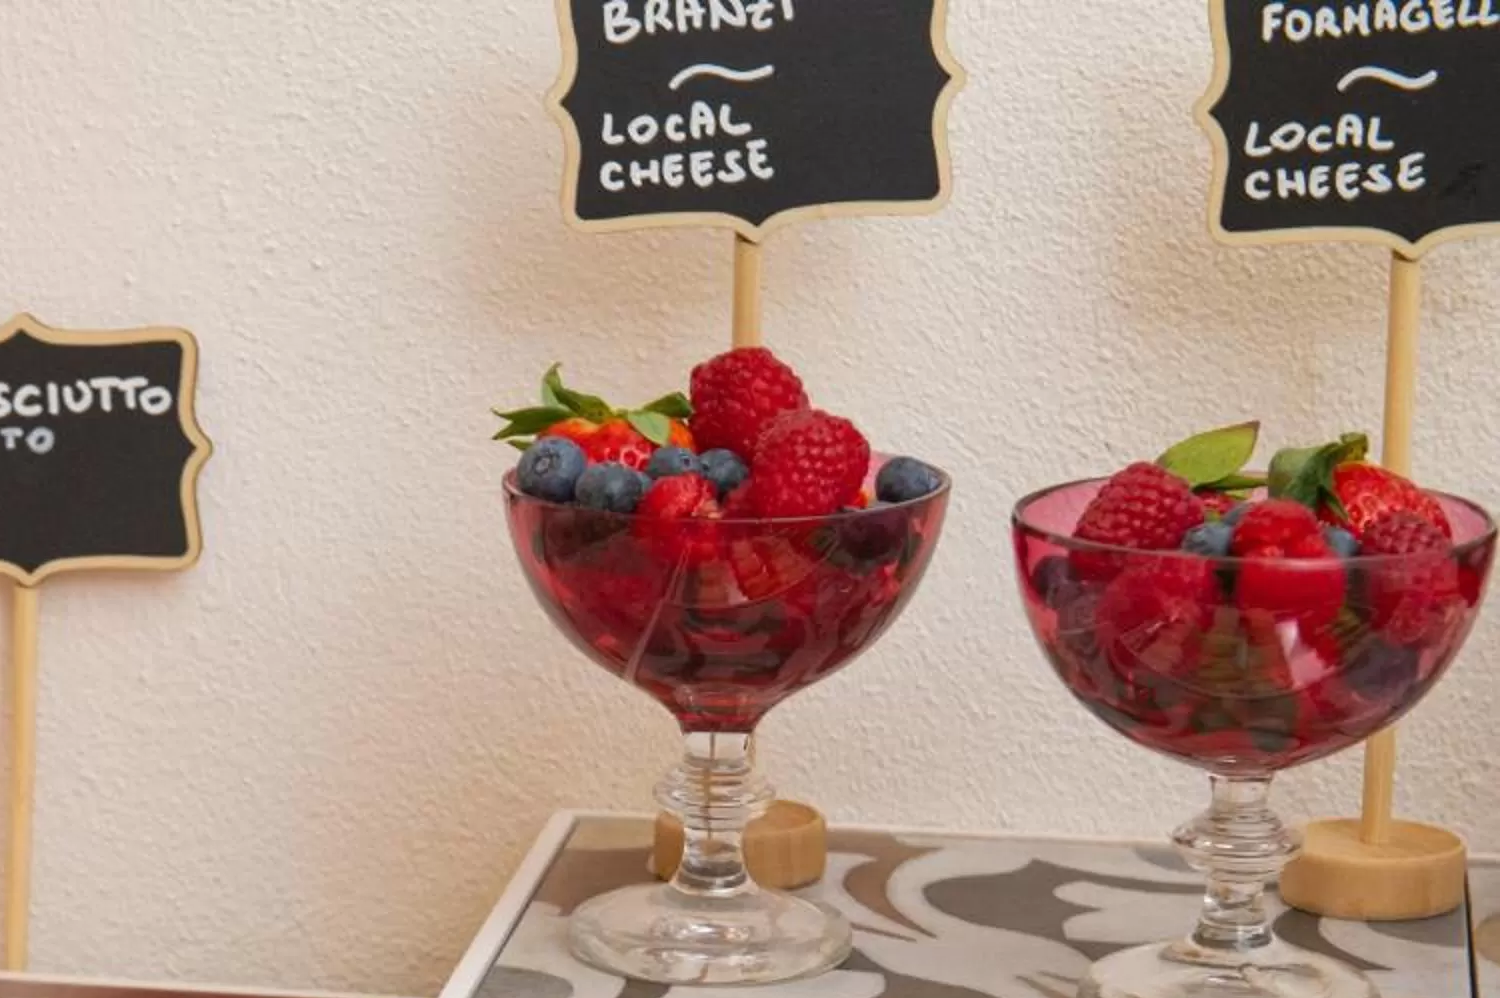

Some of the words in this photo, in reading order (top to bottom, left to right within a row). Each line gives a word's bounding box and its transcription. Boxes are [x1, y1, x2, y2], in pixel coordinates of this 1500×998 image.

[601, 100, 753, 146] LOCAL
[1243, 113, 1395, 157] LOCAL
[599, 138, 775, 192] CHEESE
[1243, 151, 1426, 201] CHEESE
